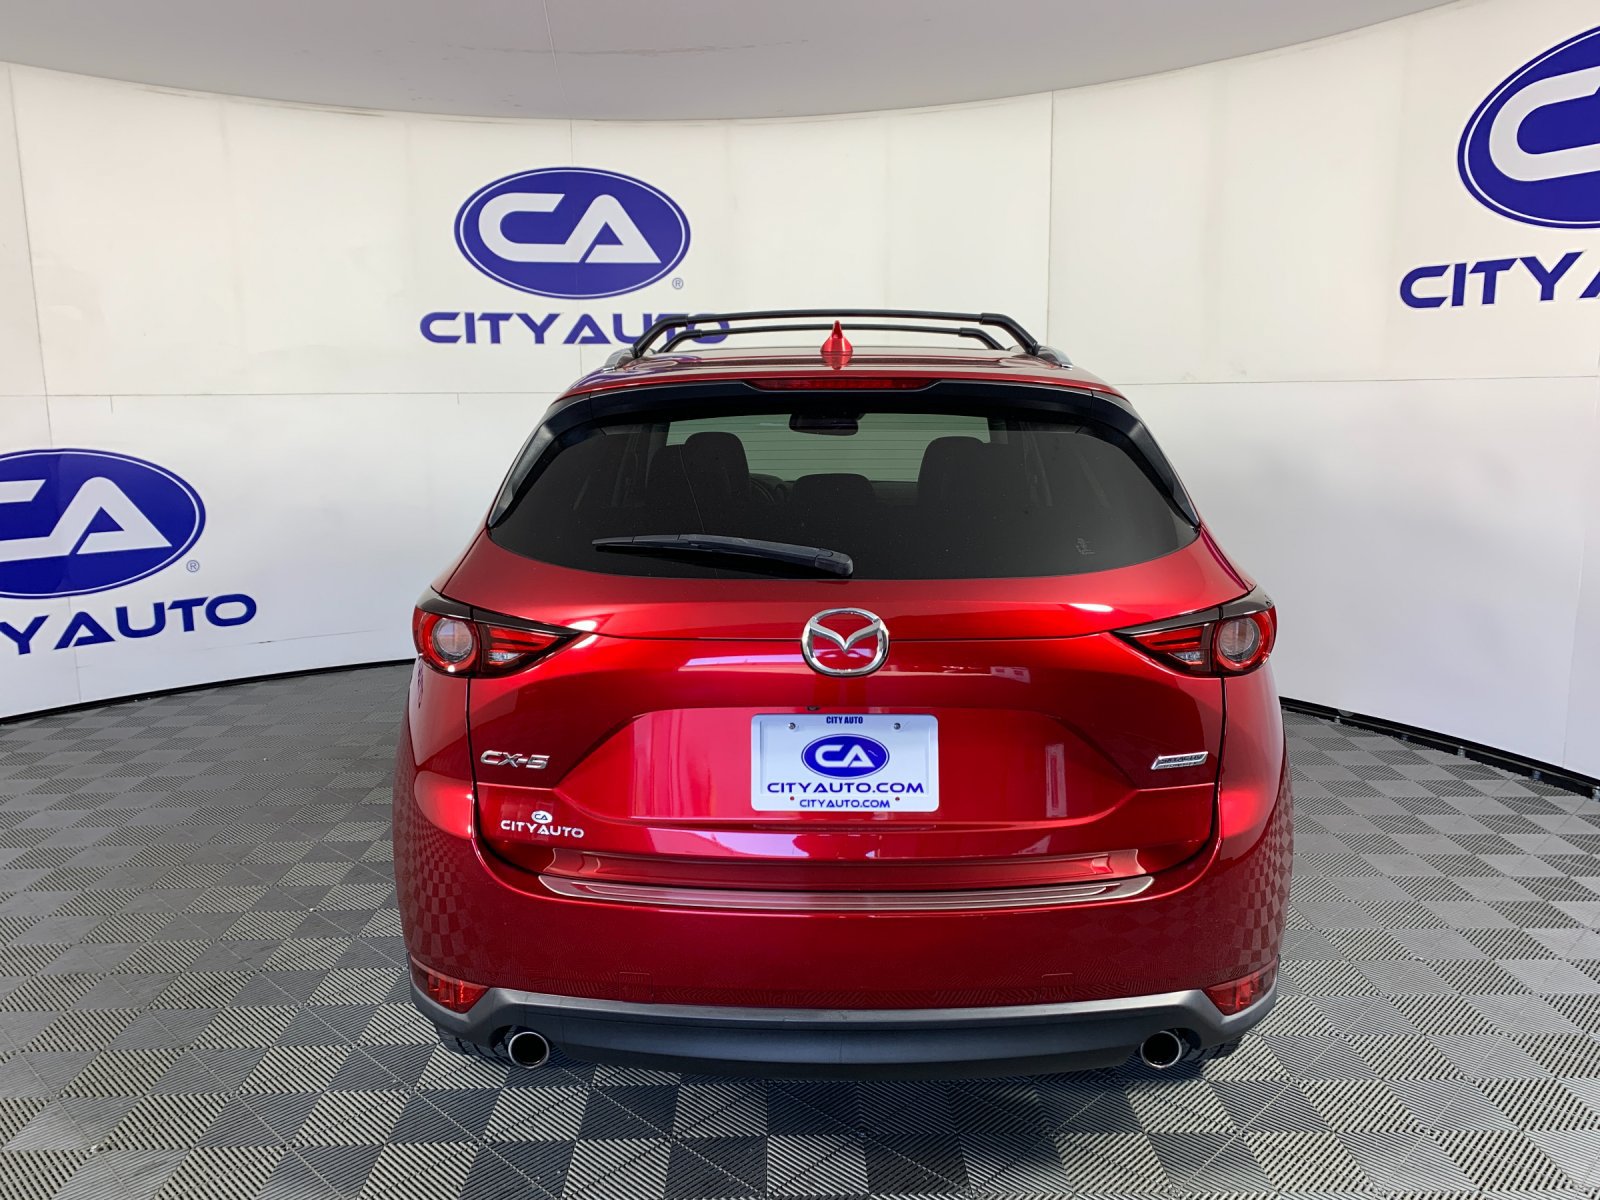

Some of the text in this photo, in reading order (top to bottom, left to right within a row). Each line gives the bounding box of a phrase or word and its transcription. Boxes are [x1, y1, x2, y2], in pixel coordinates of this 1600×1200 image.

[478, 192, 662, 263] CA
[1400, 250, 1600, 309] CITY
[826, 716, 863, 724] CITY AUTO
[480, 750, 550, 769] CX-5
[815, 744, 875, 768] CA
[767, 782, 924, 794] CITYAUTO.COM
[799, 799, 890, 808] CITYAUTO.COM
